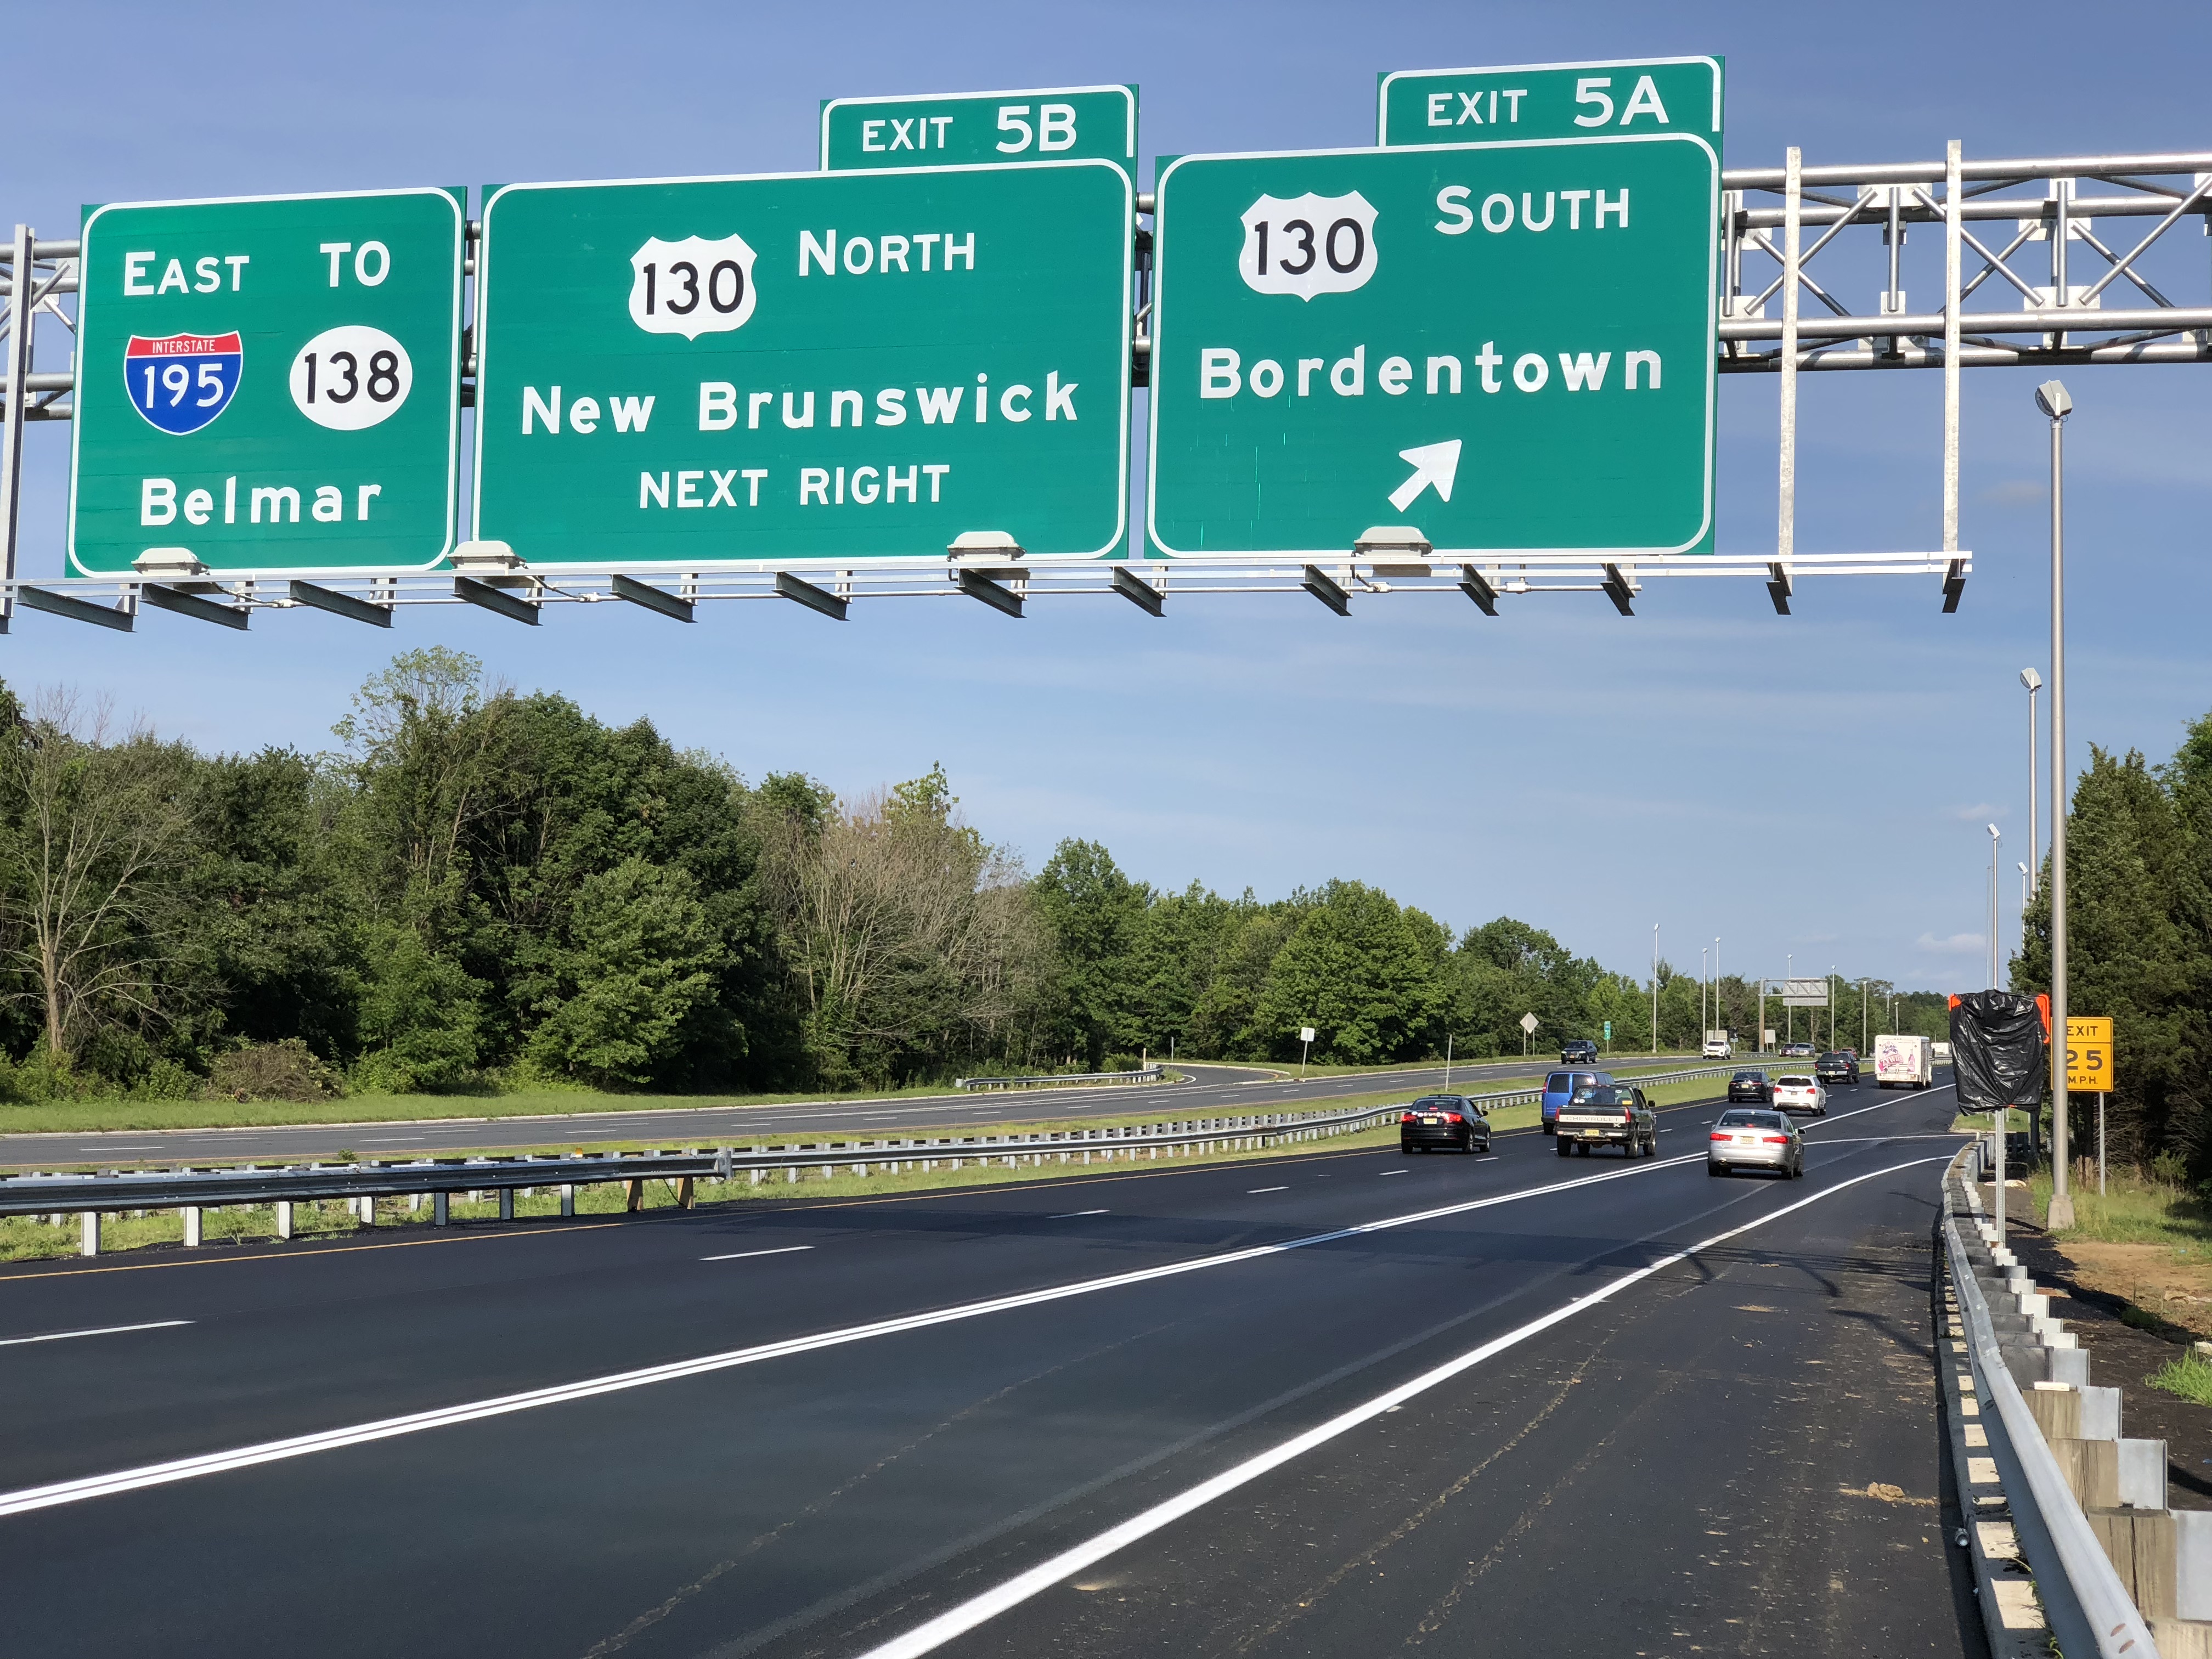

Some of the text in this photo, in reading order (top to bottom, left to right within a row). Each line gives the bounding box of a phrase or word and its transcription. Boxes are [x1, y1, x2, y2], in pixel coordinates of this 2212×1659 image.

[1427, 75, 1670, 127] EXIT 5A
[862, 104, 1077, 154] EXIT 5B
[1434, 185, 1629, 235] SOUTH
[320, 240, 391, 288] TO
[799, 229, 975, 277] NORTH
[1254, 218, 1365, 275] 130
[124, 251, 250, 296] EAST
[643, 260, 744, 315] 130
[152, 339, 216, 354] INTERSTATE
[1200, 341, 1662, 399] Bordentown
[144, 363, 224, 409] 195
[304, 350, 400, 404] 138
[522, 370, 1079, 435] New Brunswick
[140, 475, 382, 527] Belmar
[640, 464, 951, 509] NEXT RIGHT
[2067, 1025, 2098, 1036] EXIT
[2067, 1049, 2103, 1071] 25
